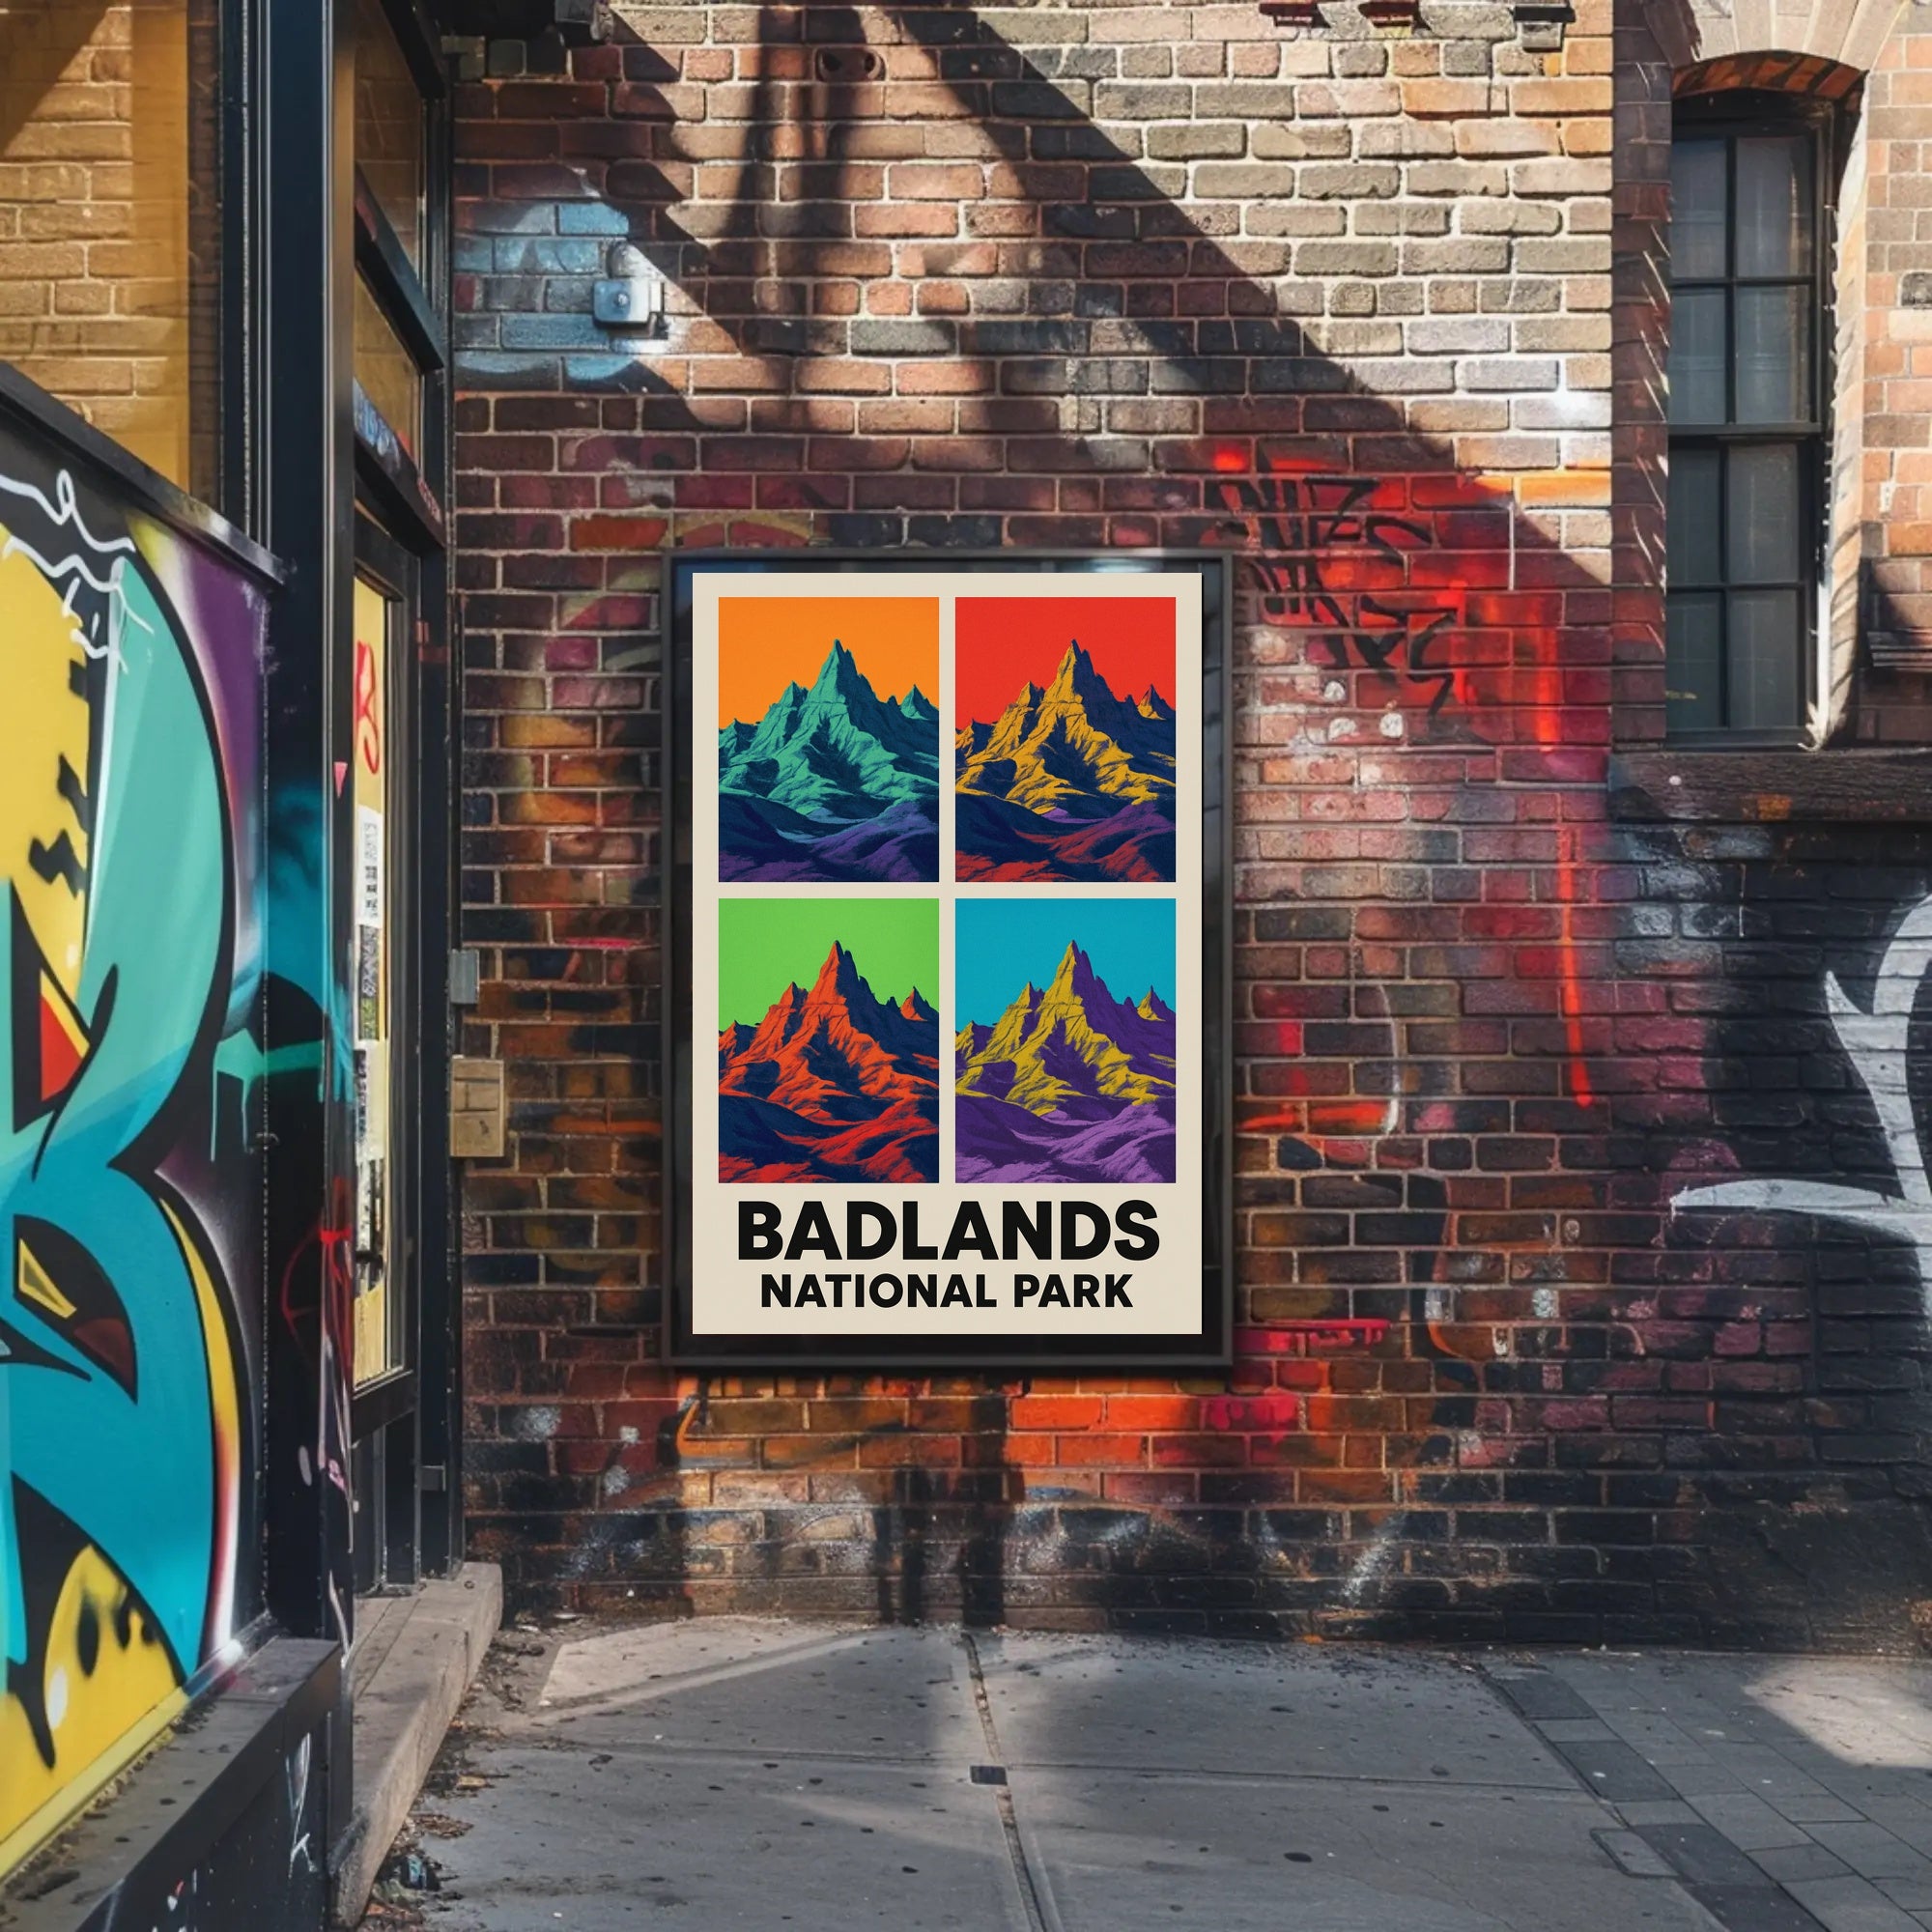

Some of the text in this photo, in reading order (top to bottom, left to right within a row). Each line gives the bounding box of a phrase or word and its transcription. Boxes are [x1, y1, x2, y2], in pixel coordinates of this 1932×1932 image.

[738, 1199, 1160, 1261] BADLANDS
[761, 1272, 1134, 1308] NATIONAL PARK
